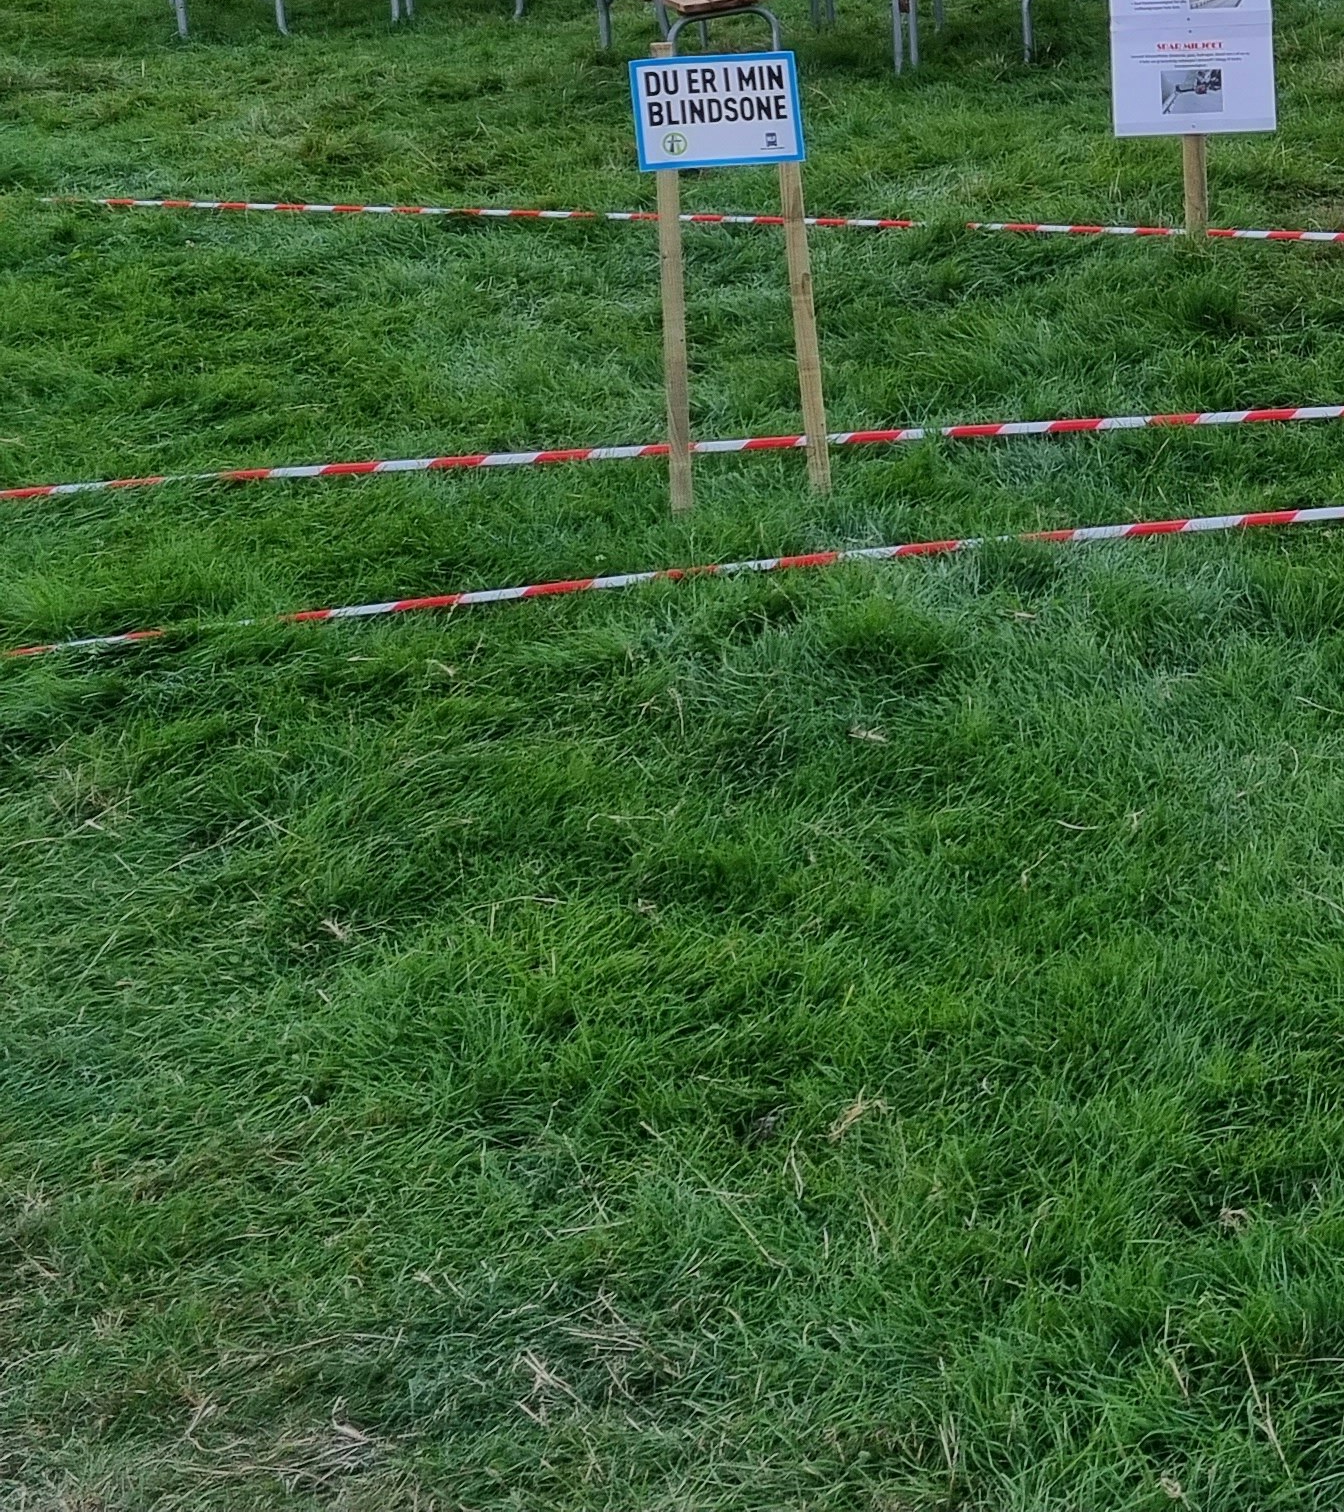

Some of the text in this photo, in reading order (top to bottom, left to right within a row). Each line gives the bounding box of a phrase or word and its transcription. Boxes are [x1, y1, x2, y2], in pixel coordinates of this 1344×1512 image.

[644, 64, 784, 97] DU ER I MIN
[647, 95, 788, 127] BLINDSONE
